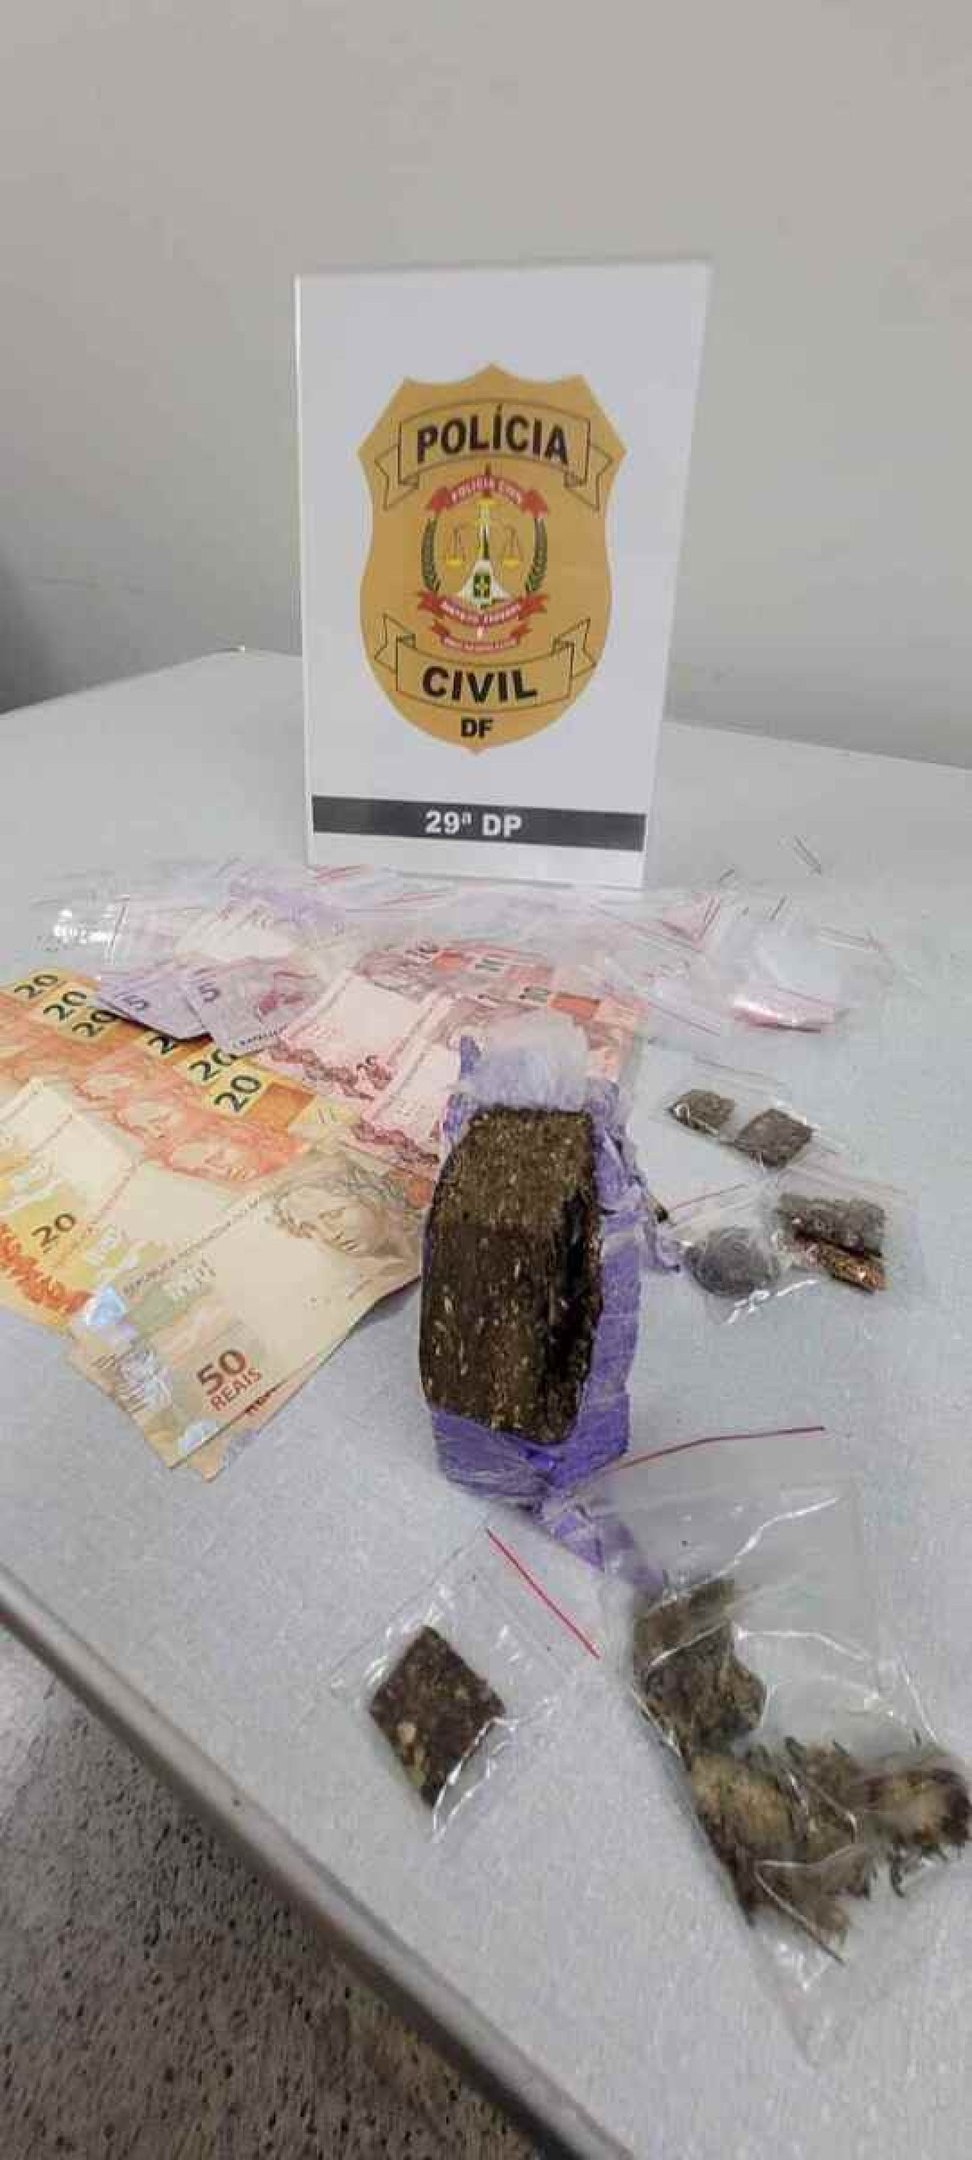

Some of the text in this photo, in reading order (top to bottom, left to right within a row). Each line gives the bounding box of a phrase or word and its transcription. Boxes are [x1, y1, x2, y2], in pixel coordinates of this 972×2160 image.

[416, 404, 568, 464] POLÍCIA
[422, 665, 538, 703] CIVIL
[460, 716, 494, 738] DF
[425, 809, 522, 838] 29ª DP
[14, 974, 59, 999] 20
[43, 991, 87, 1021] 20
[71, 1009, 118, 1037] 20
[147, 1035, 178, 1056] 2
[188, 1048, 238, 1081] 20
[213, 1074, 262, 1113] 20
[31, 1213, 76, 1248] 20
[197, 1349, 247, 1396] 50
[210, 1367, 262, 1412] REAIS
